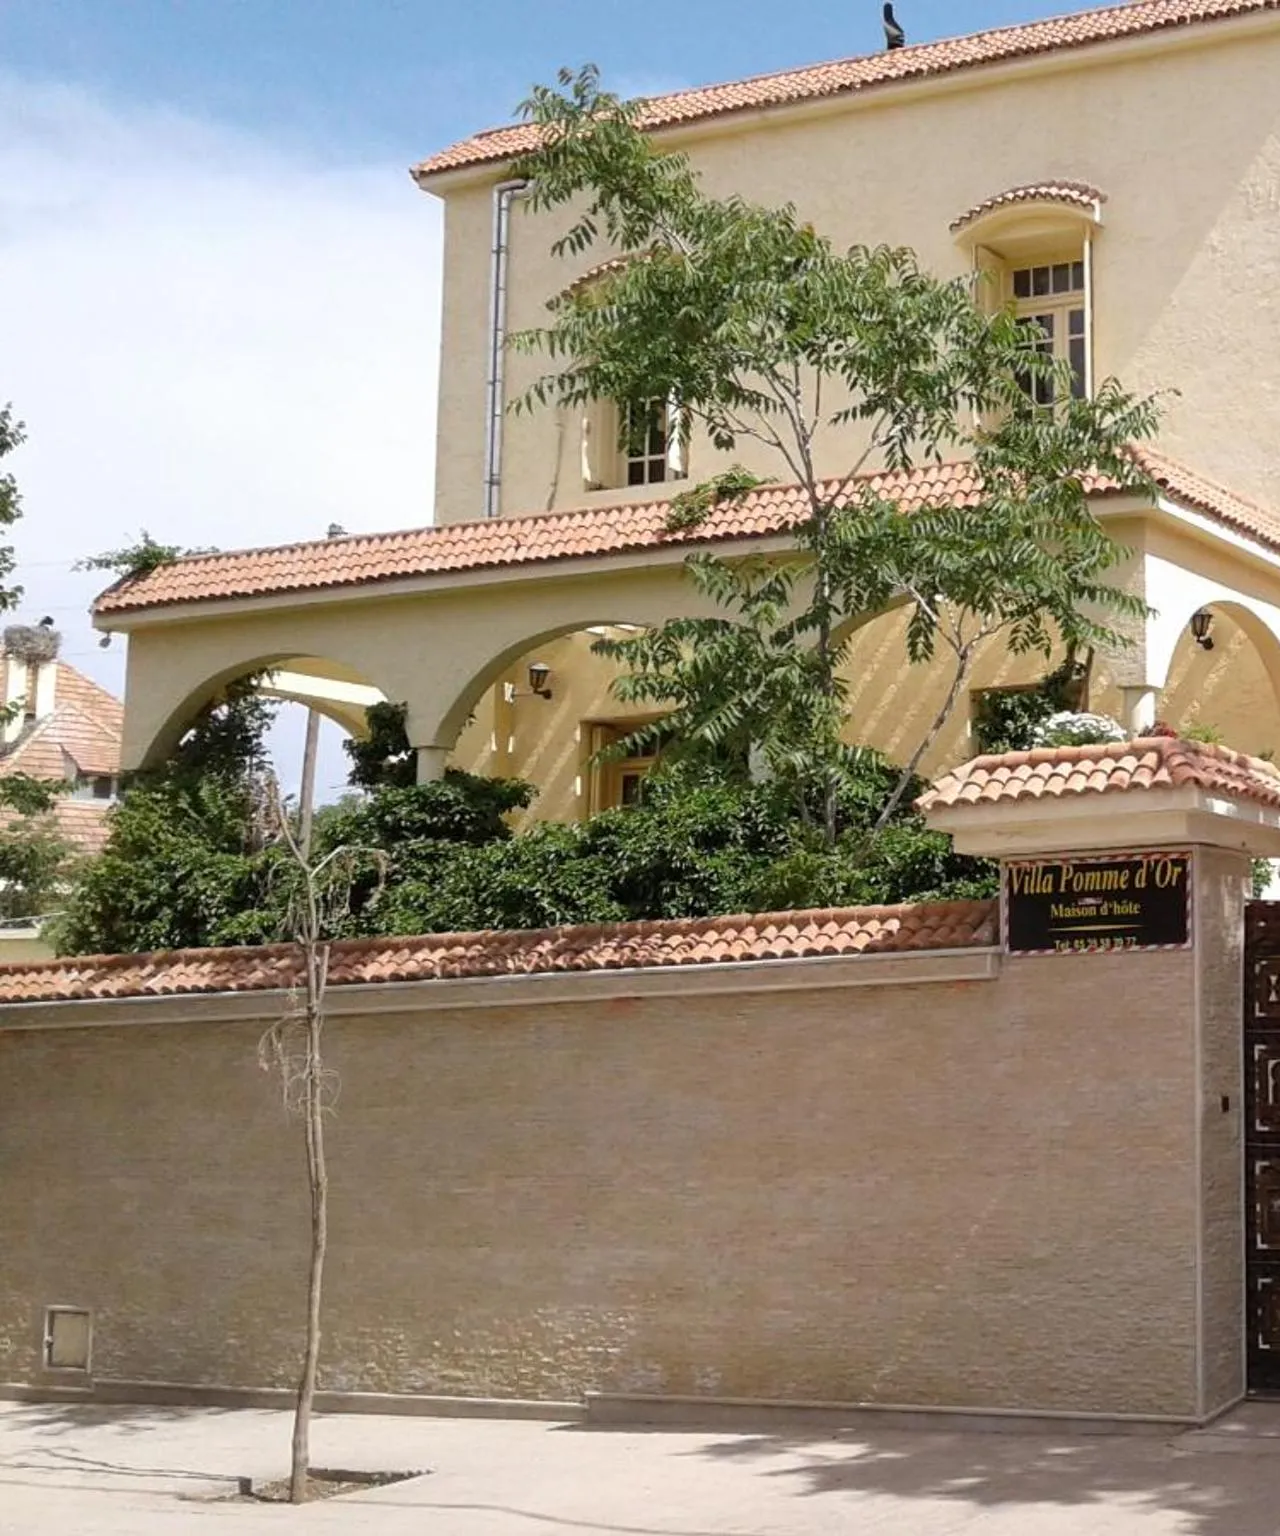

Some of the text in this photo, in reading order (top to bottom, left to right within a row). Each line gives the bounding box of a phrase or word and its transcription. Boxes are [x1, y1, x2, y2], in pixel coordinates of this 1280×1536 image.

[1011, 858, 1183, 895] Villa Pomme d'Or
[1051, 903, 1097, 918] Maison
